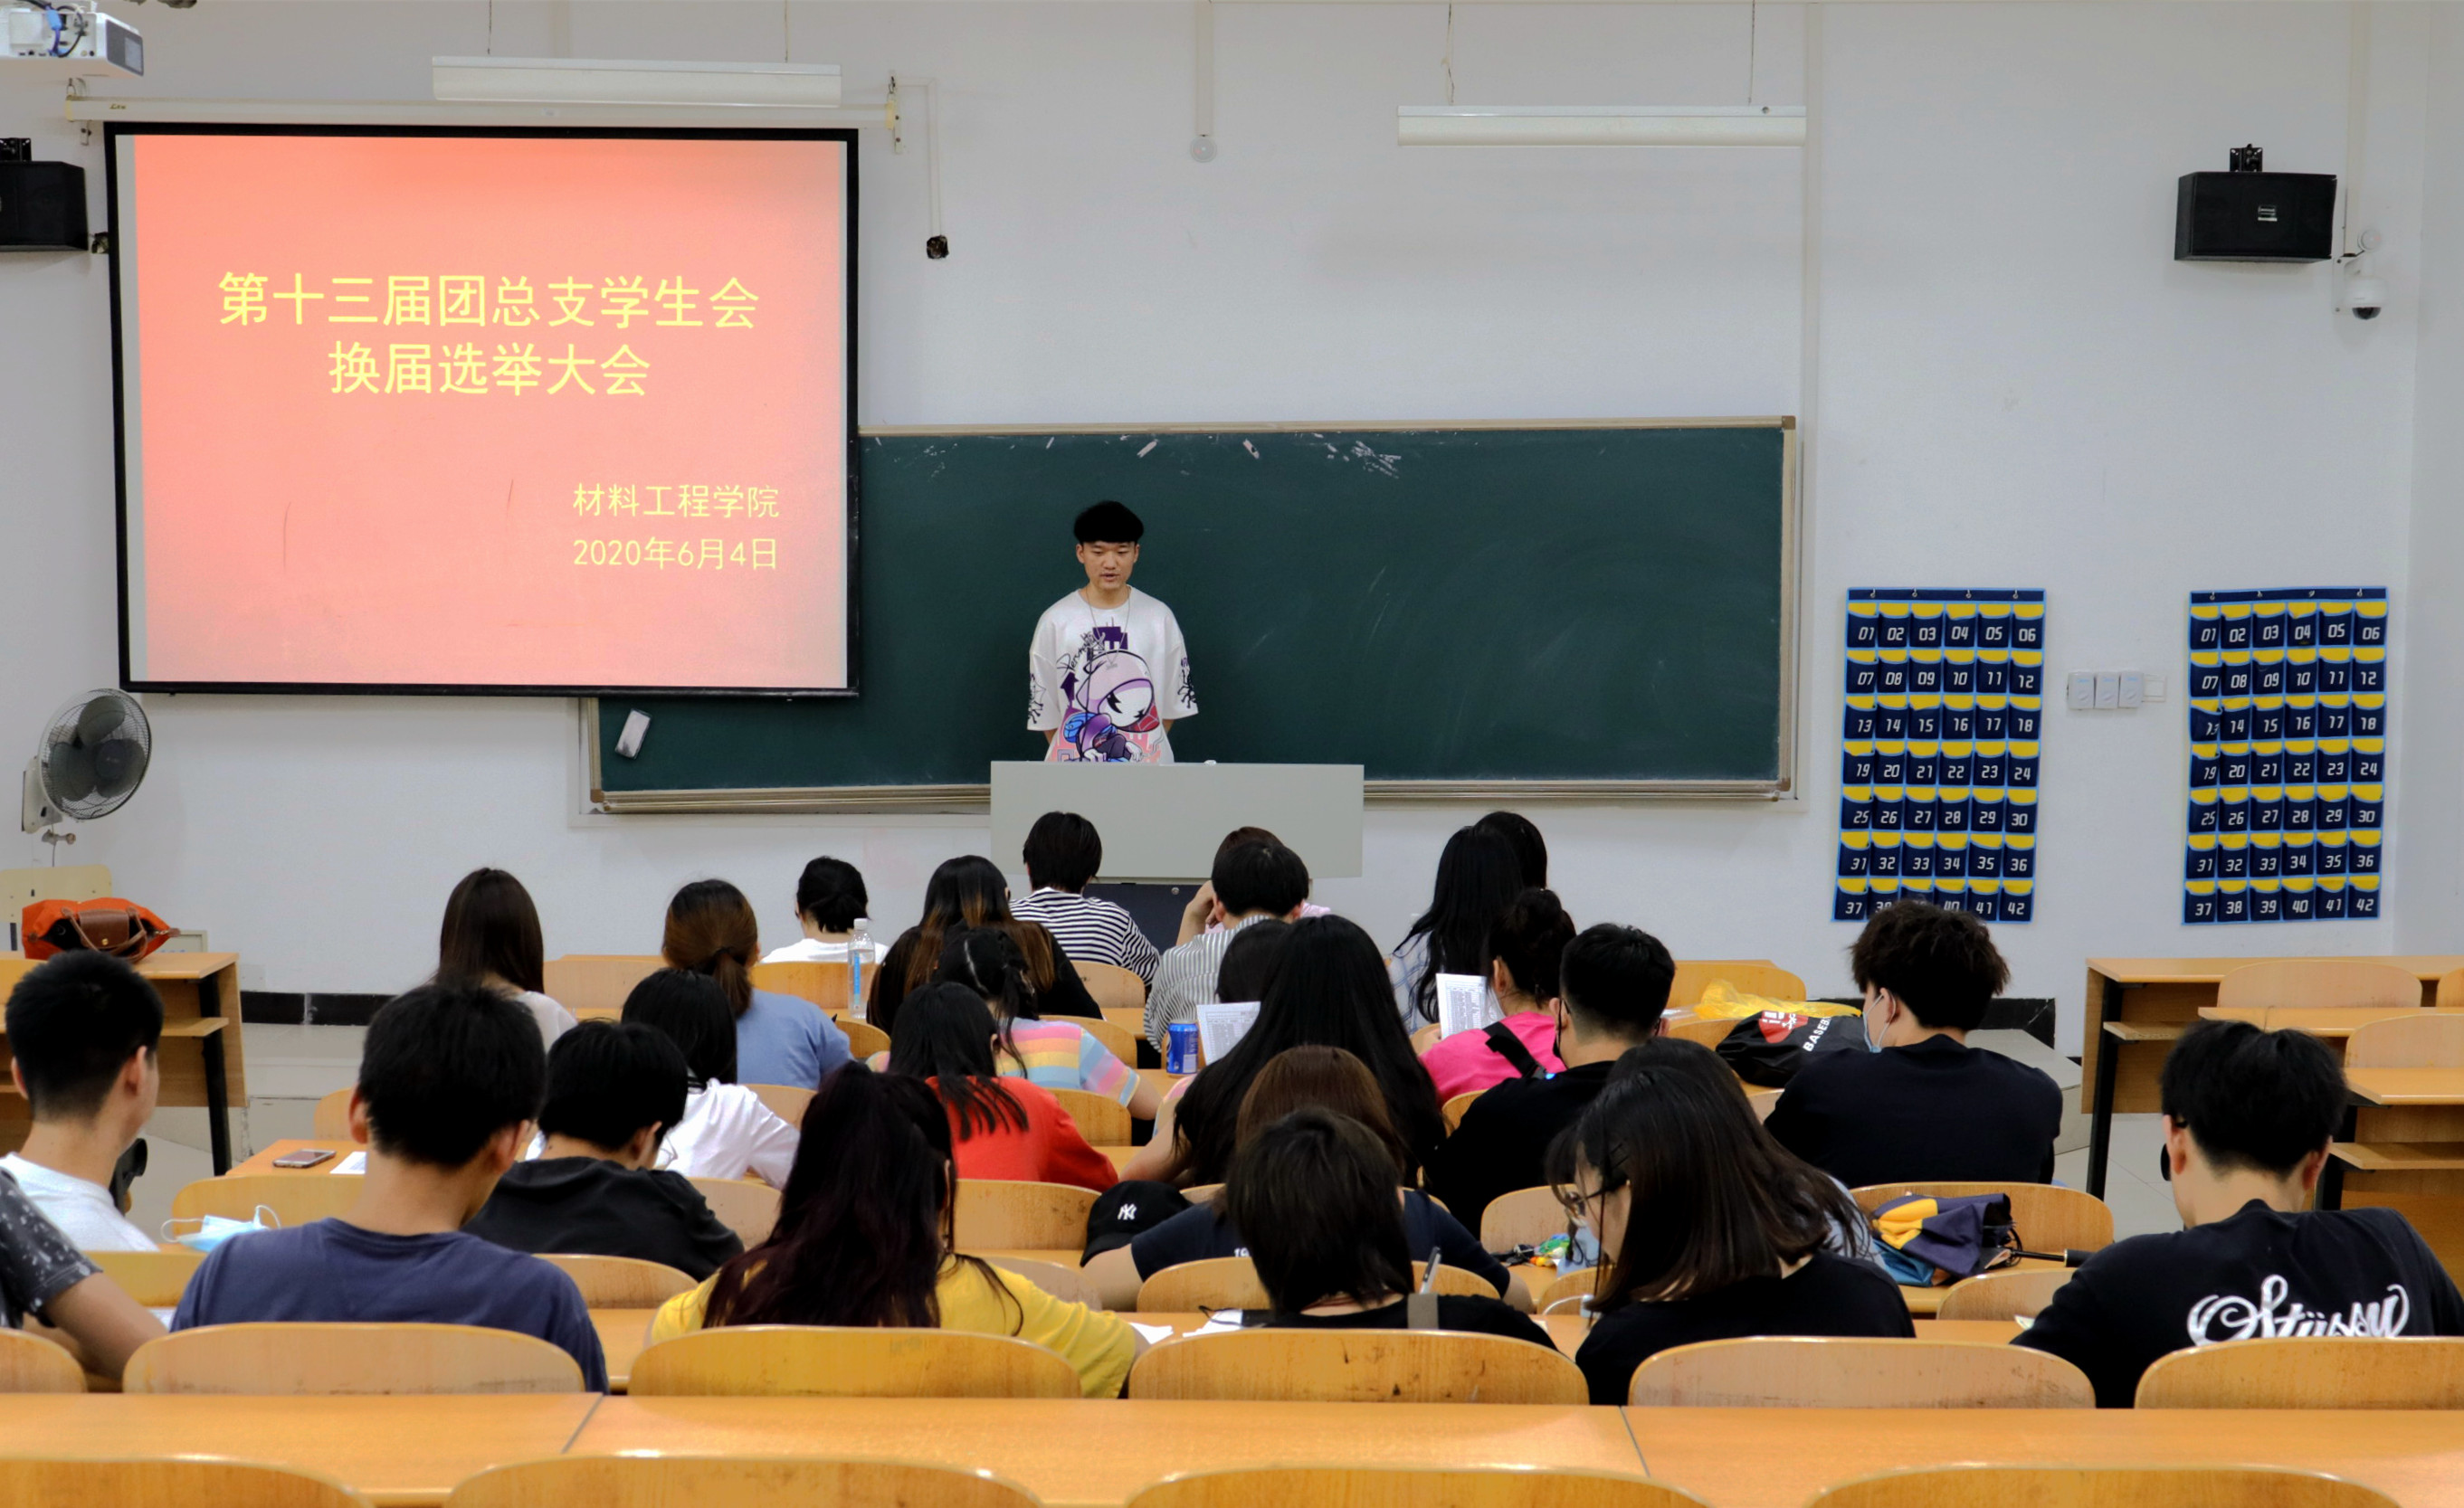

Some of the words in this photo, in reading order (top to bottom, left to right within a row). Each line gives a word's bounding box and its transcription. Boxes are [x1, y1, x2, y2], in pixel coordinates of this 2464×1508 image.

[218, 271, 759, 329] 第十三届团总支学生会
[328, 340, 651, 396] 换届选举大会
[573, 482, 780, 518] 材料工程学院
[573, 536, 776, 571] 2020年6月4日
[1858, 626, 1875, 640] 01
[1887, 627, 1905, 641] 02
[1918, 627, 1936, 641] 03
[1951, 626, 1969, 640] 04
[1985, 626, 2003, 640] 05
[2018, 628, 2036, 642] 06
[2201, 628, 2216, 642] 01
[2229, 627, 2246, 642] 02
[2262, 624, 2279, 640] 03
[2294, 624, 2311, 640] 04
[2327, 623, 2345, 638] 05
[2362, 626, 2381, 640] 06
[1857, 671, 1874, 686] 07
[1885, 671, 1903, 686] 08
[1917, 671, 1936, 686] 09
[1954, 671, 1968, 686] 10
[1987, 671, 2002, 685] 11
[2019, 675, 2034, 688] 12
[2202, 676, 2219, 689] 07
[2231, 674, 2248, 688] 08
[2263, 672, 2279, 688] 09
[2297, 671, 2311, 687] 10
[2329, 670, 2345, 685] 11
[2361, 671, 2377, 686] 12
[1858, 719, 1872, 733] 13
[1887, 718, 1901, 733] 14
[1919, 718, 1934, 733] 15
[1954, 717, 1968, 732] 16
[1986, 717, 2002, 731] 17
[2018, 717, 2033, 733] 18
[2205, 722, 2220, 736] 13
[2231, 719, 2244, 734] 14
[2264, 718, 2278, 733] 15
[2296, 716, 2311, 730] 16
[2329, 716, 2345, 729] 17
[2361, 716, 2376, 730] 18
[1857, 763, 1870, 777] 19
[1883, 763, 1900, 778] 20
[1917, 764, 1933, 779] 21
[1947, 765, 1965, 779] 22
[1981, 764, 1998, 779] 23
[2014, 766, 2031, 781] 24
[2203, 766, 2217, 780] 19
[2229, 764, 2246, 778] 20
[2261, 763, 2278, 777] 21
[2293, 763, 2310, 776] 22
[2327, 762, 2345, 776] 23
[2360, 762, 2377, 776] 24
[1853, 811, 1869, 824] 25
[1880, 811, 1898, 824] 26
[1914, 810, 1932, 824] 27
[1945, 811, 1961, 824] 28
[1979, 811, 1996, 824] 29
[2011, 812, 2028, 826] 30
[2201, 811, 2215, 826] 25
[2228, 811, 2244, 826] 26
[2262, 809, 2278, 823] 27
[2292, 810, 2309, 823] 28
[2326, 809, 2343, 822] 29
[2358, 810, 2375, 822] 30
[1850, 858, 1867, 870] 31
[1879, 856, 1896, 870] 32
[1912, 857, 1930, 870] 33
[1944, 858, 1960, 870] 34
[1977, 856, 1995, 870] 35
[2011, 858, 2028, 872] 36
[2197, 858, 2212, 872] 31
[2225, 858, 2243, 872] 32
[2259, 858, 2277, 871] 33
[2290, 855, 2307, 869] 34
[2325, 854, 2342, 868] 35
[2356, 854, 2374, 868] 36
[1845, 902, 1862, 915] 37
[1975, 901, 1993, 915] 41
[2007, 902, 2025, 915] 42
[2195, 903, 2212, 916] 37
[2226, 900, 2242, 915] 38
[2259, 899, 2277, 914] 39
[2292, 899, 2308, 913] 40
[2326, 898, 2342, 912] 41
[2356, 898, 2374, 911] 42
[1118, 1203, 1137, 1220] NY
